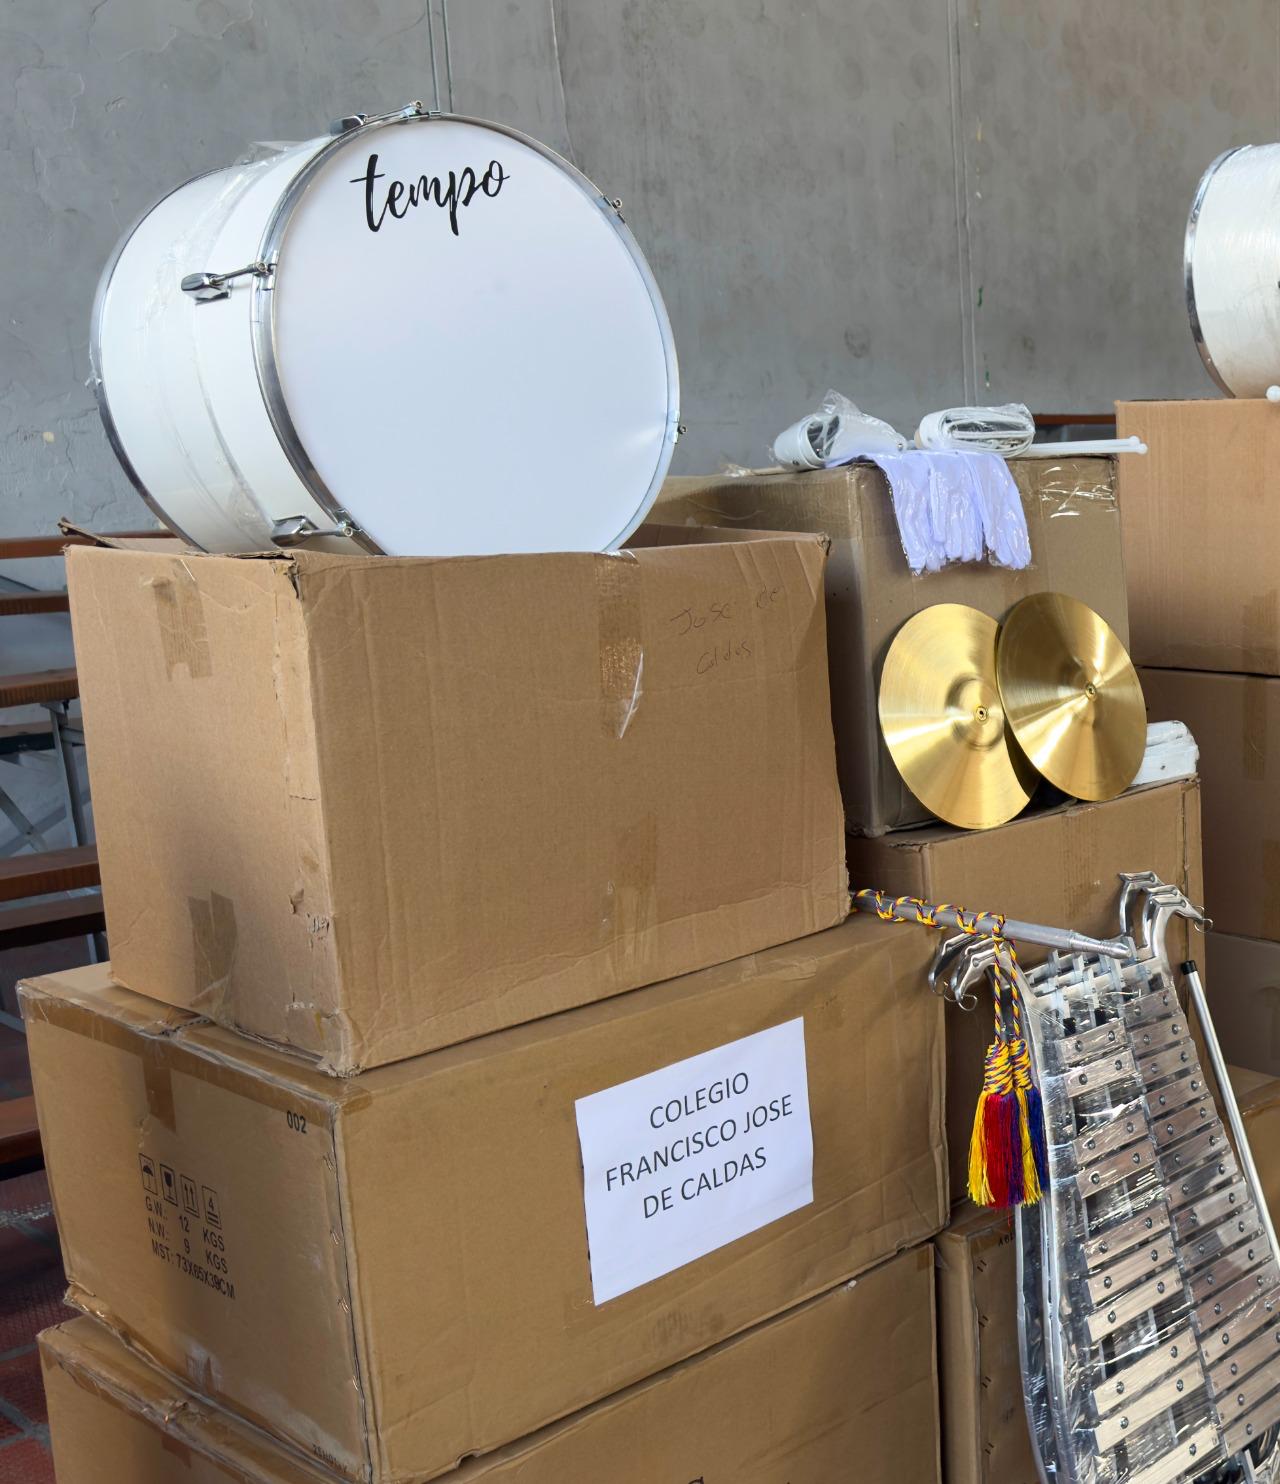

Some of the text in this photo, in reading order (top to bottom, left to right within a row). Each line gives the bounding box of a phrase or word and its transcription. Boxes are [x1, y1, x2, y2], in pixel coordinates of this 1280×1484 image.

[349, 154, 511, 236] tempo
[286, 1110, 308, 1134] 002
[649, 1072, 749, 1129] COLEGIO
[605, 1094, 793, 1192] FRANCISCO JOSE
[643, 1147, 767, 1219] DE CALDAS
[179, 1215, 190, 1233] 12
[202, 1227, 225, 1252] KGS
[183, 1239, 191, 1254] 9
[205, 1249, 229, 1274] KGS
